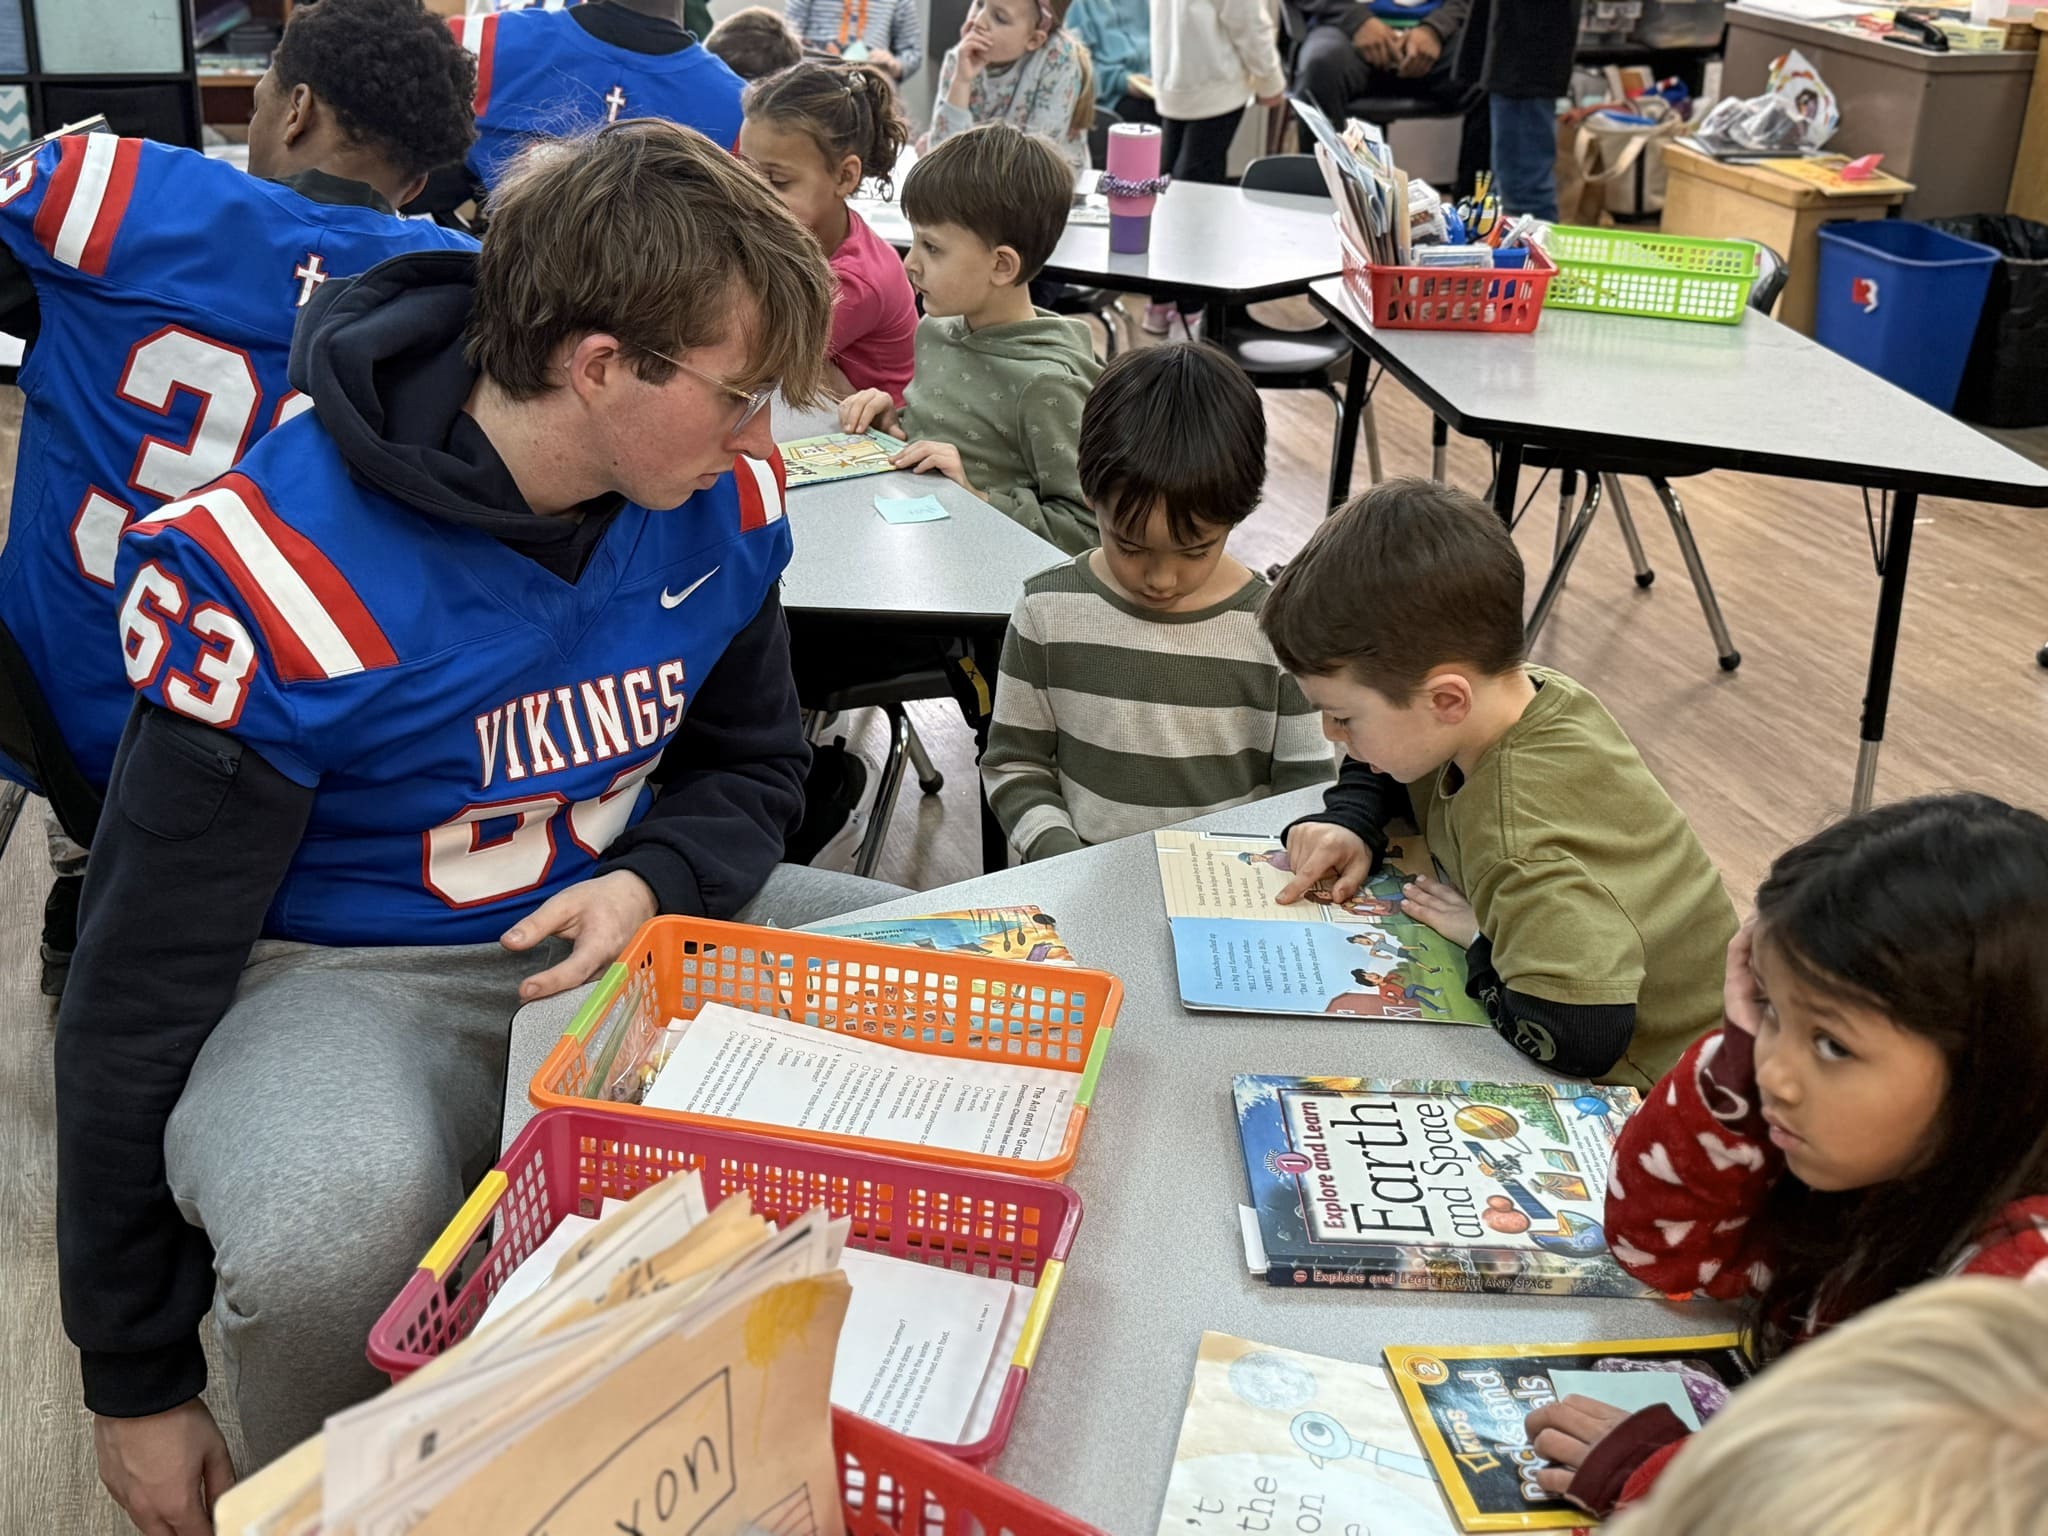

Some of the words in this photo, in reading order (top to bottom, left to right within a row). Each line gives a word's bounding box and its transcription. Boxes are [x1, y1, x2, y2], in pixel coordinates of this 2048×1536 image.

[117, 558, 260, 730] 63
[475, 658, 685, 790] VIKINGS
[1209, 940, 1220, 954] pulled
[1307, 948, 1318, 962] called
[1212, 954, 1222, 981] Lambchops
[1243, 955, 1256, 969] yelled
[1229, 966, 1238, 974] red
[1311, 962, 1323, 985] Lambchop
[1231, 974, 1240, 982] big
[1280, 972, 1289, 982] took
[1215, 981, 1223, 990] The
[1282, 983, 1292, 994] They
[763, 1042, 774, 1053] What
[998, 1090, 1009, 1101] What
[1015, 1084, 1029, 1108] Directions:
[1033, 1087, 1046, 1099] The
[1056, 1090, 1068, 1103] Name
[1029, 1100, 1041, 1112] Ant
[1007, 1108, 1020, 1126] Choose
[1024, 1113, 1034, 1126] and
[1300, 1102, 1325, 1140] Learn
[1005, 1126, 1014, 1134] the
[1019, 1127, 1031, 1138] the
[1001, 1134, 1011, 1145] best
[1415, 1103, 1473, 1177] Space
[1303, 1143, 1332, 1171] and
[1329, 1101, 1435, 1236] Earth
[1316, 1174, 1348, 1229] Explore
[1427, 1186, 1484, 1239] and
[1313, 1270, 1365, 1284] Explore
[1369, 1273, 1394, 1284] and
[1486, 1279, 1512, 1289] AND
[1516, 1279, 1552, 1290] SPACE
[891, 1319, 908, 1345] summer?
[938, 1330, 951, 1346] food.
[885, 1345, 896, 1358] next
[900, 1345, 914, 1362] dance.
[918, 1339, 932, 1359] winter.
[932, 1346, 945, 1362] much
[895, 1362, 906, 1373] and
[913, 1358, 924, 1368] the
[926, 1362, 939, 1376] need
[1418, 1362, 1441, 1376] 2
[874, 1365, 889, 1377] likely
[909, 1368, 919, 1376] for
[869, 1377, 880, 1390] most
[890, 1373, 903, 1384] sing
[903, 1375, 916, 1388] food
[922, 1375, 932, 1385] not
[881, 1389, 892, 1401] how
[899, 1388, 911, 1401] have
[917, 1385, 928, 1394] will
[1458, 1367, 1518, 1419] and
[914, 1394, 923, 1402] he
[1446, 1408, 1481, 1453] KIDS
[1236, 1476, 1278, 1531] the
[1296, 1494, 1325, 1534] on
